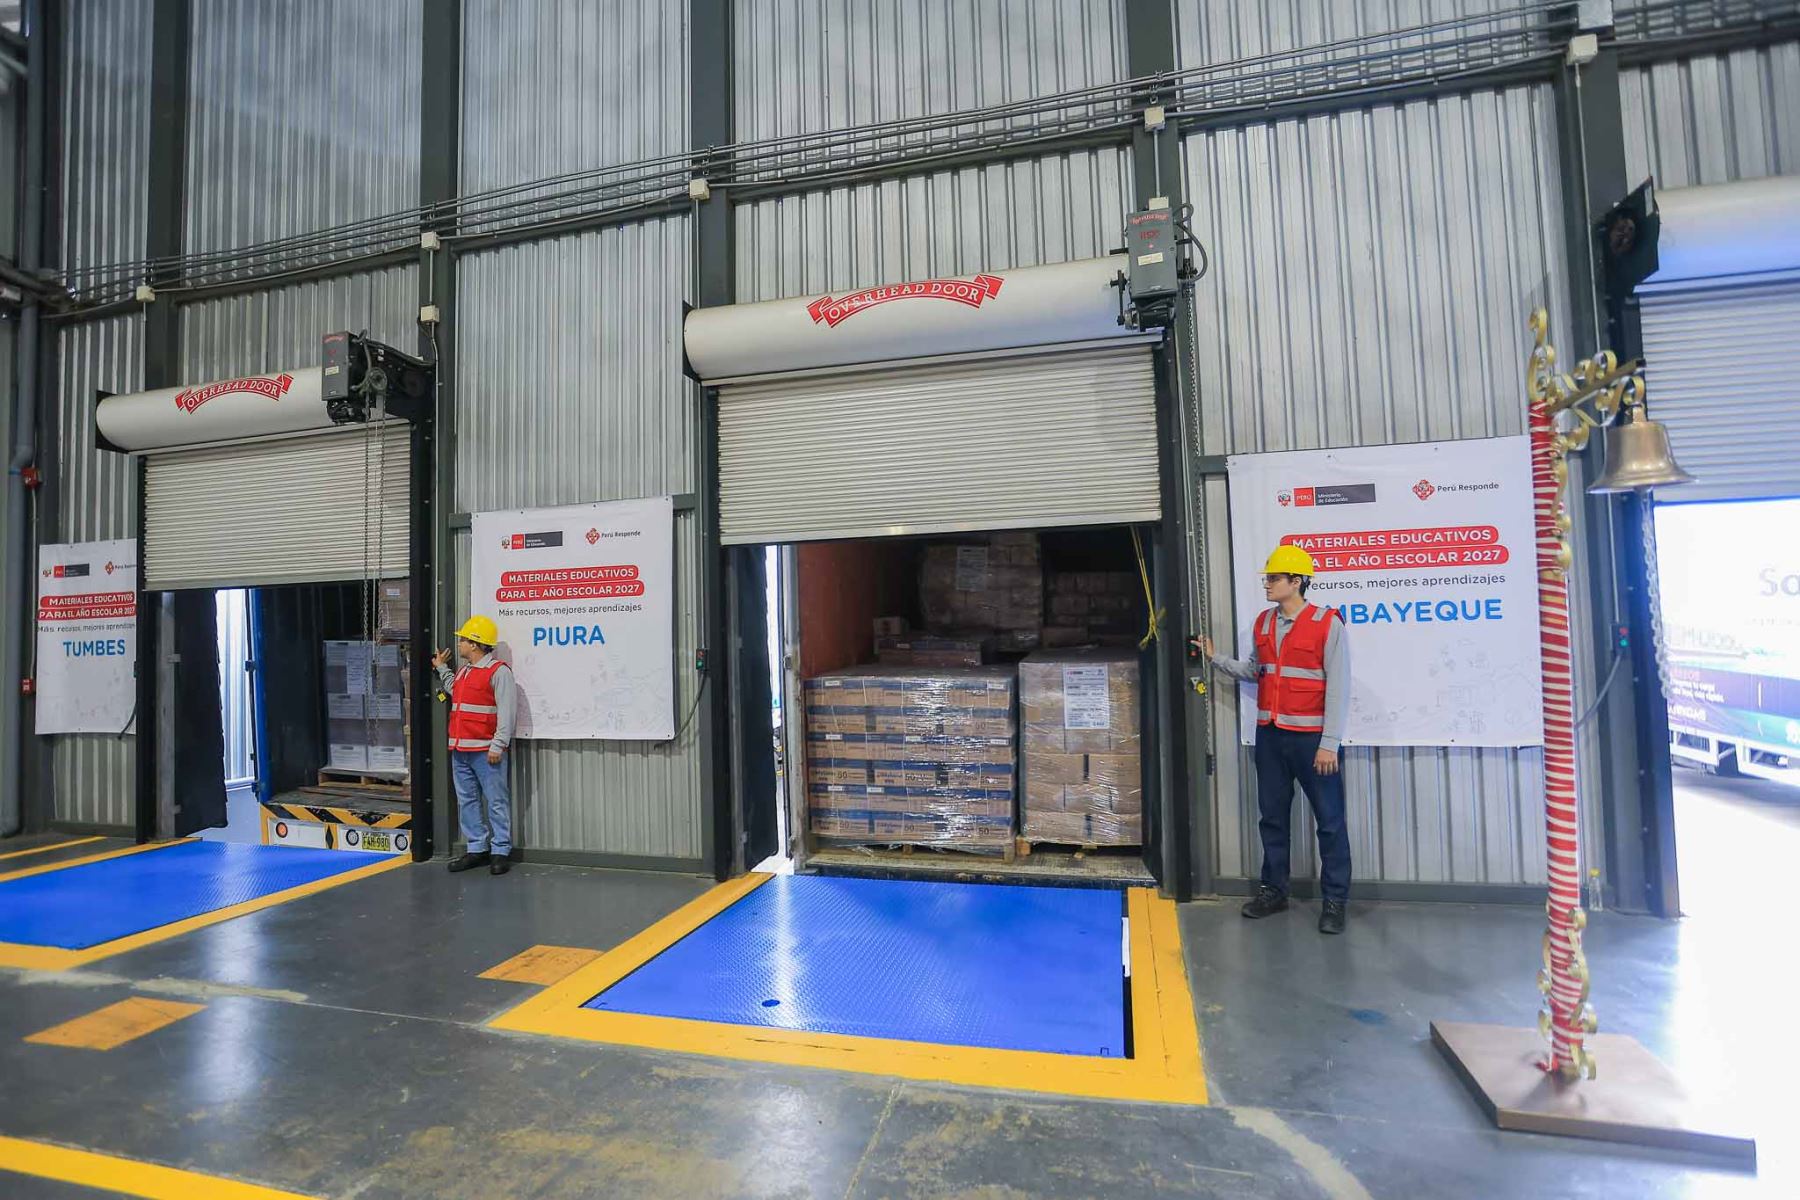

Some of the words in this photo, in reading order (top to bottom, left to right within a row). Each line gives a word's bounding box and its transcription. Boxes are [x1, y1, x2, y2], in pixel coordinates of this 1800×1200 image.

[828, 283, 925, 320] OVERHEAD
[930, 283, 979, 302] DOOR
[187, 380, 247, 408] OVERHEAD
[249, 381, 278, 396] DOOR
[1437, 484, 1456, 492] Perú
[1458, 482, 1500, 492] Responde
[1292, 534, 1386, 550] MATERIALES
[1390, 529, 1492, 545] EDUCATIVOS
[1325, 557, 1343, 567] EL
[1347, 553, 1381, 566] AÑO
[1385, 551, 1458, 565] ESCOLAR
[1462, 549, 1501, 562] 2027
[508, 571, 568, 583] MATERIALES
[570, 568, 634, 580] EDUCATIVOS
[1366, 577, 1418, 590] mejores
[1421, 573, 1506, 588] aprendizajes
[49, 596, 93, 606] MATERIALES
[94, 593, 133, 603] EDUCATIVOS
[500, 590, 526, 599] PARA
[528, 589, 540, 598] EL
[542, 586, 564, 597] AÑO
[566, 585, 613, 596] ESCOLAR
[615, 584, 640, 594] 2027
[39, 611, 66, 619] PARA
[67, 610, 75, 618] EL
[75, 608, 90, 617] AÑO
[91, 607, 123, 617] ESCOLAR
[499, 608, 514, 617] Más
[515, 607, 552, 617] recursos,
[553, 605, 587, 615] mejores
[588, 602, 643, 614] aprendizajes
[1325, 598, 1503, 624] BAYEQUE
[533, 625, 605, 646] PIURA
[63, 639, 126, 657] TUMBES
